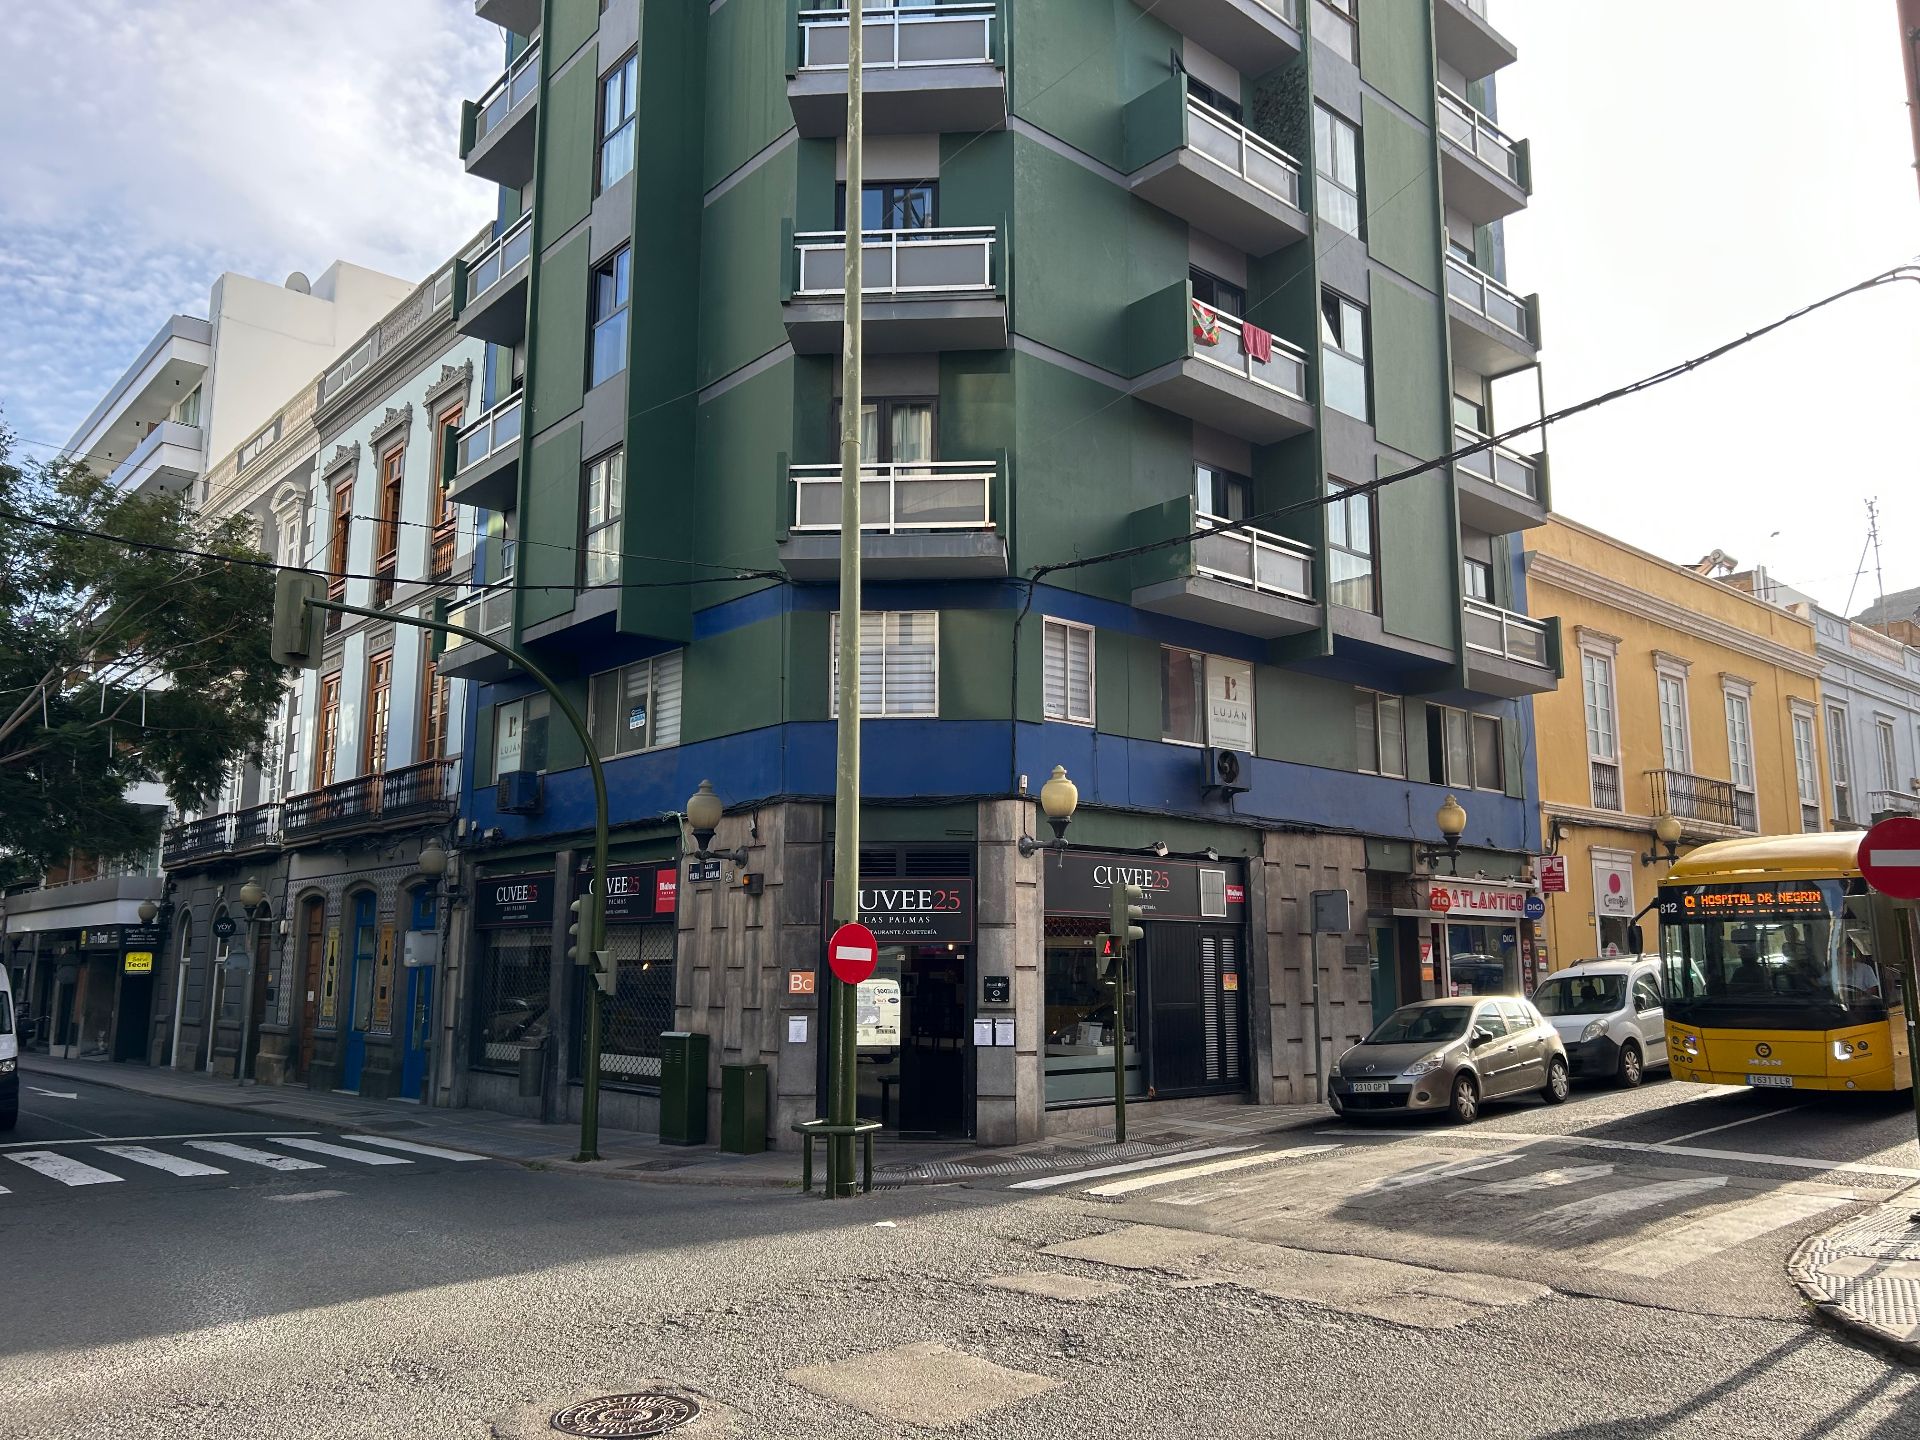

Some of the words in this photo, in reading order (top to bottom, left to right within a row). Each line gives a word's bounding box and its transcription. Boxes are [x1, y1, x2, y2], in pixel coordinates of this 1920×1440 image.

[1540, 858, 1563, 873] PC
[1093, 865, 1170, 889] CUVEE25
[496, 884, 538, 903] CUVEE25
[858, 889, 961, 910] UVEE25
[1431, 894, 1450, 906] ria
[1450, 889, 1524, 912] ATLANTICO
[1701, 894, 1754, 906] HOSPITAL
[1778, 891, 1821, 904] NEGRIN
[1527, 903, 1543, 911] DIGI
[1660, 903, 1678, 914] 812
[864, 916, 884, 924] LAS
[888, 916, 931, 924] PALMAS
[790, 974, 813, 991] Bc
[1748, 1059, 1782, 1067] MAN
[1354, 1083, 1372, 1092] 2310
[1753, 1075, 1774, 1084] 1631
[1774, 1076, 1791, 1086] LLR
